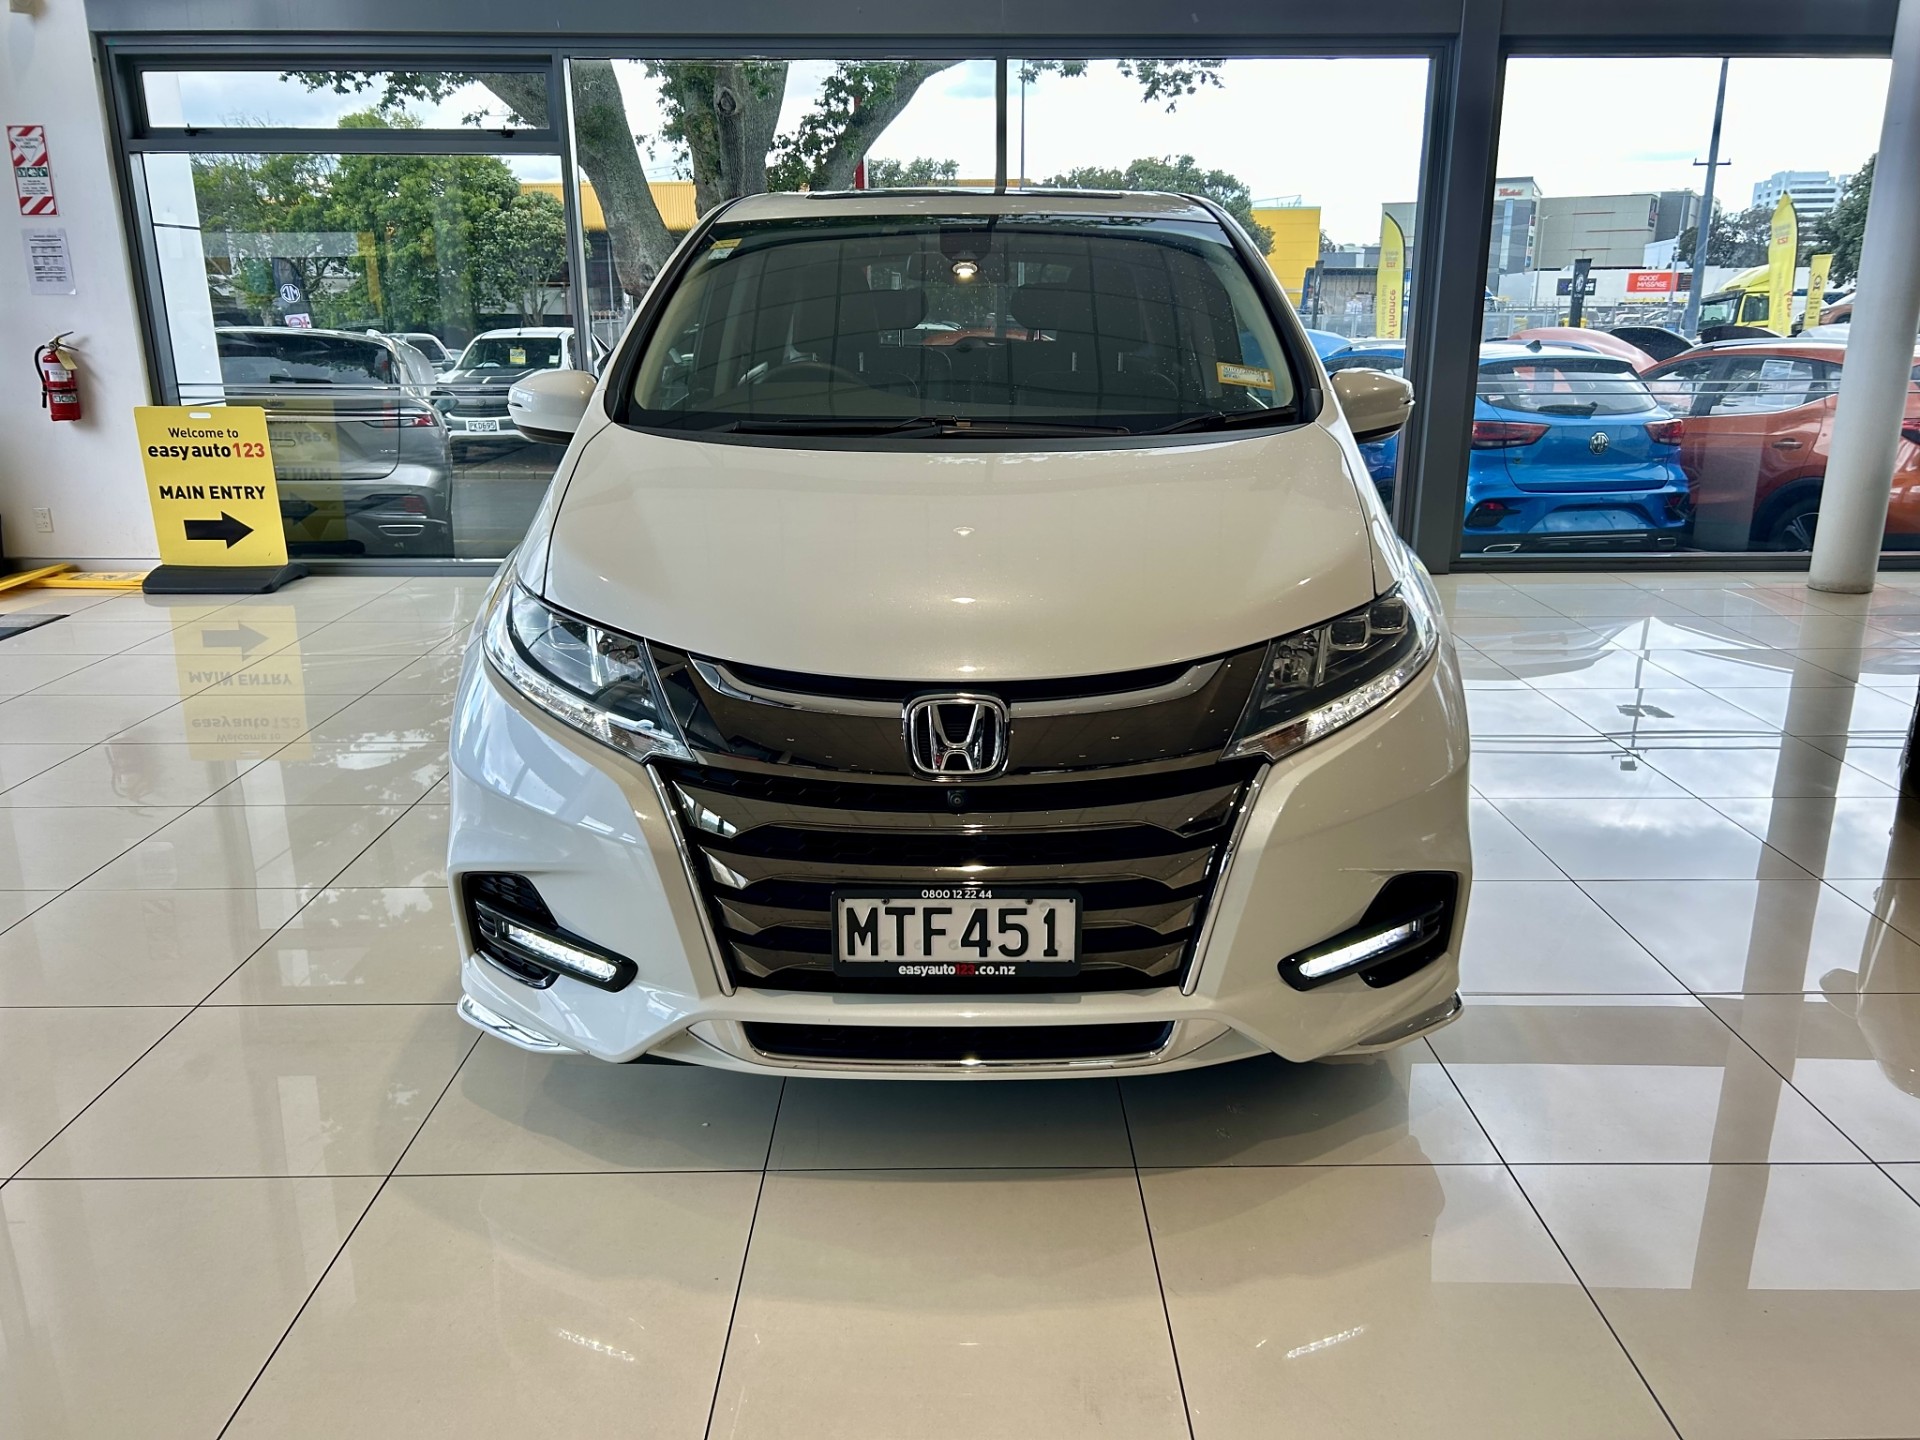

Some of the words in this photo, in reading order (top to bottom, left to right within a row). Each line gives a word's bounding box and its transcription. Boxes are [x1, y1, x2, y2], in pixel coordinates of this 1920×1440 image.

[168, 427, 224, 439] Welcome
[227, 428, 239, 439] to
[148, 442, 265, 461] easyauto123
[159, 485, 205, 500] MAIN
[209, 485, 266, 500] ENTRY
[921, 889, 951, 899] 0800
[952, 889, 963, 899] 12
[964, 889, 977, 899] 22
[978, 889, 993, 899] 44
[846, 906, 1059, 958] MTF451
[898, 964, 1016, 977] easyauto123.co.nz
